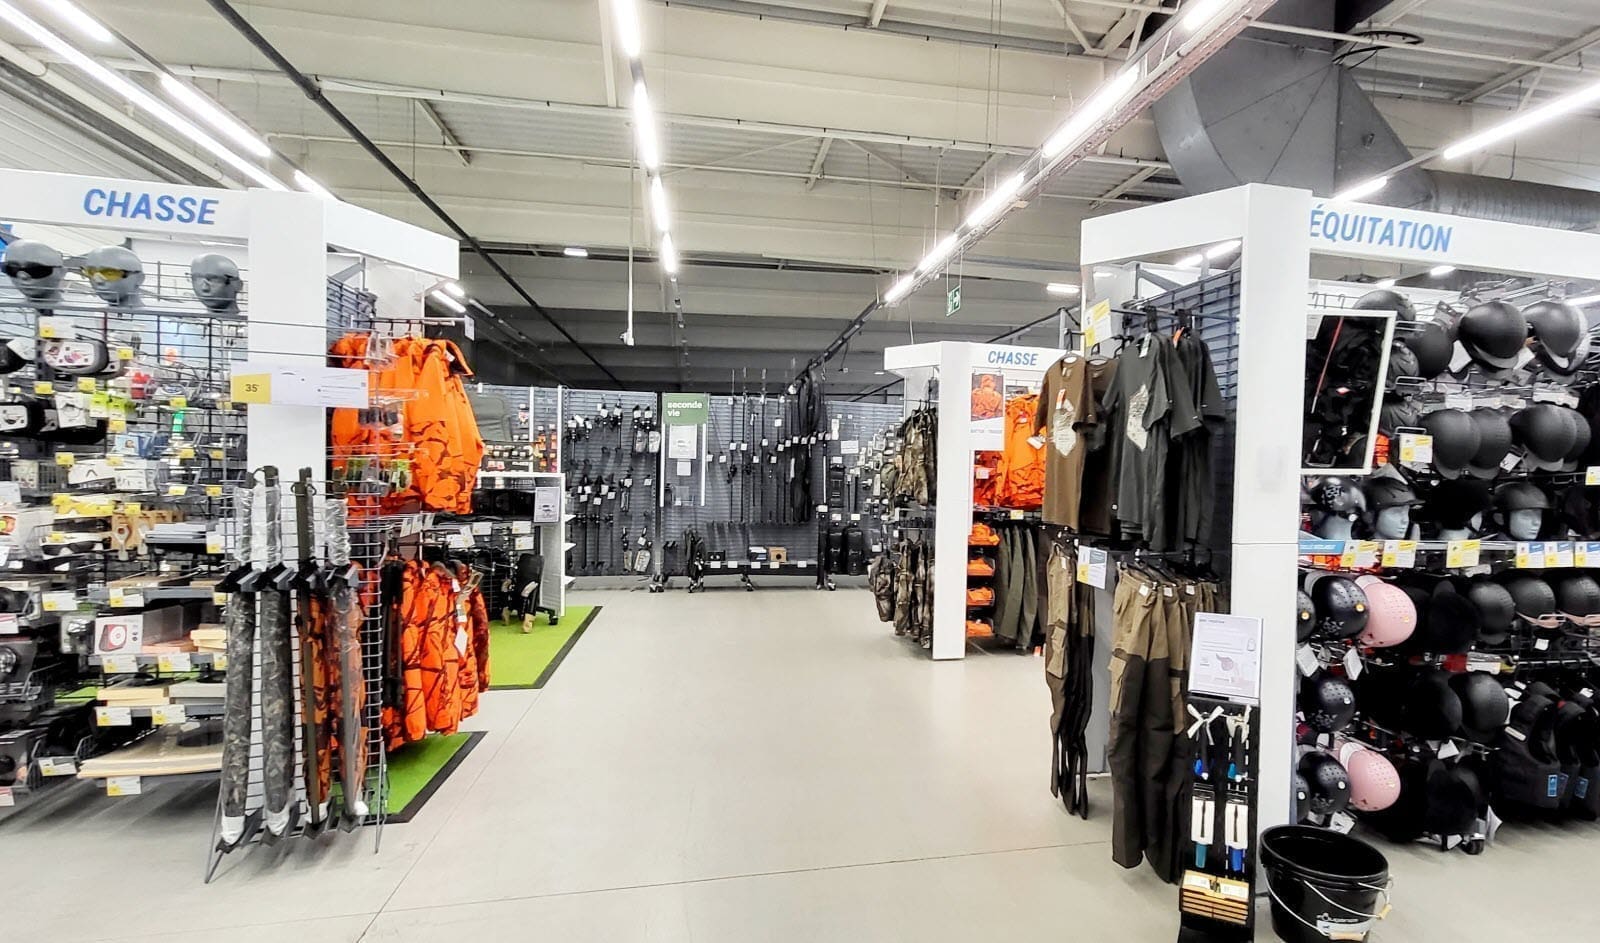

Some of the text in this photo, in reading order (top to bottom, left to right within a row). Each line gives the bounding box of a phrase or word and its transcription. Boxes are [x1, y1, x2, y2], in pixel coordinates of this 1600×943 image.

[83, 188, 219, 225] CHASSE
[1310, 204, 1452, 252] ÉQUITATION
[988, 350, 1038, 366] CHASSE
[667, 401, 702, 409] seconde
